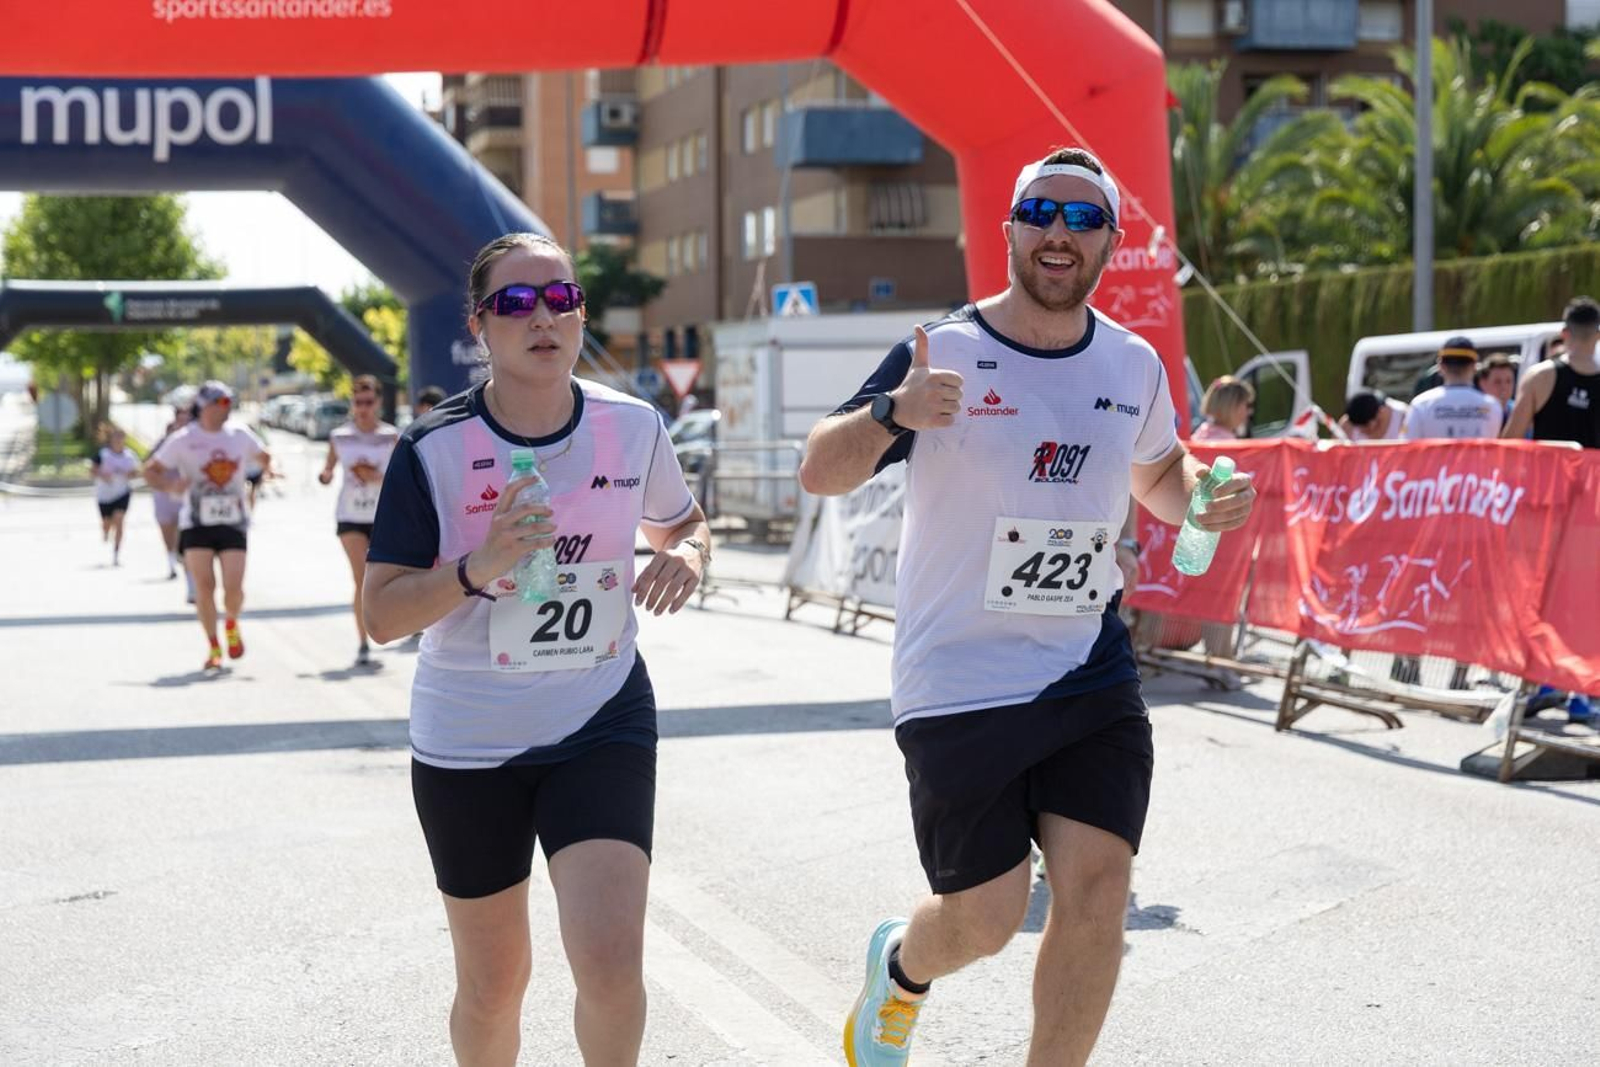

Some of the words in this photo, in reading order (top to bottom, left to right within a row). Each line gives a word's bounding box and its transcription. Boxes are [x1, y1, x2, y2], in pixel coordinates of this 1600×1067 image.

[152, 0, 393, 23] sportssantander.es
[20, 76, 273, 162] mupol
[967, 407, 1018, 416] Santander
[1116, 402, 1140, 418] mupol
[1011, 551, 1092, 590] 423
[530, 599, 592, 643] 20
[532, 648, 558, 657] CARMEN
